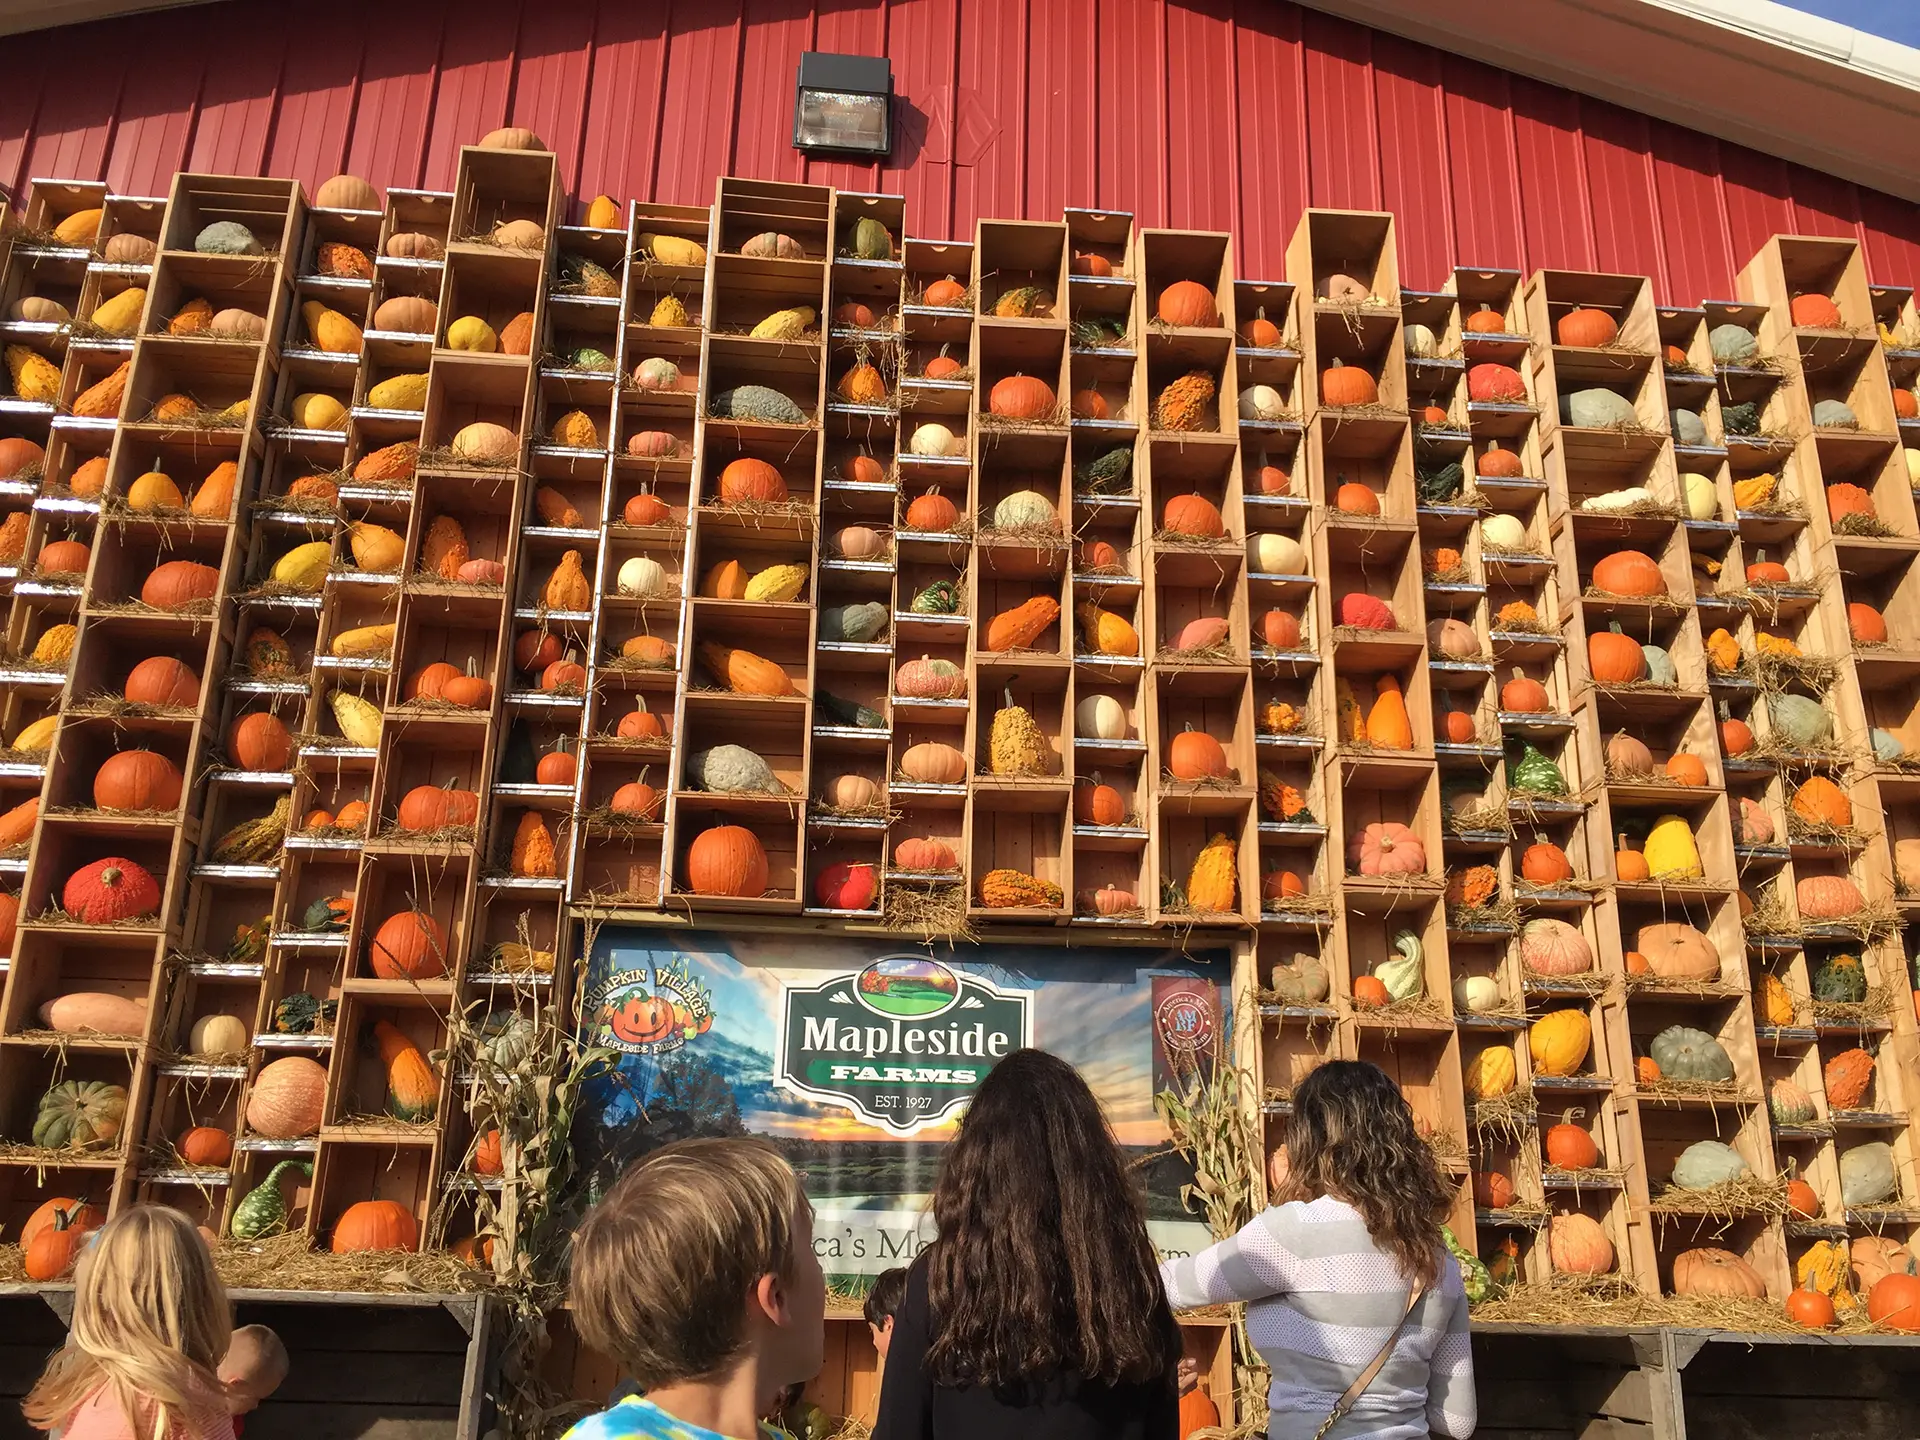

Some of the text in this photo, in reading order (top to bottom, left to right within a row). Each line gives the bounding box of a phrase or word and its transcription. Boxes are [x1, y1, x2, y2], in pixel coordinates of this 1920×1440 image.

[583, 968, 707, 1018] PUMPKIN VILLAGE
[1162, 996, 1209, 1016] America's Most
[599, 1033, 684, 1054] MAPLESIDE FARMS
[801, 1016, 1009, 1058] Mapleside
[830, 1065, 977, 1084] FARMS
[875, 1095, 932, 1109] EST. 1927
